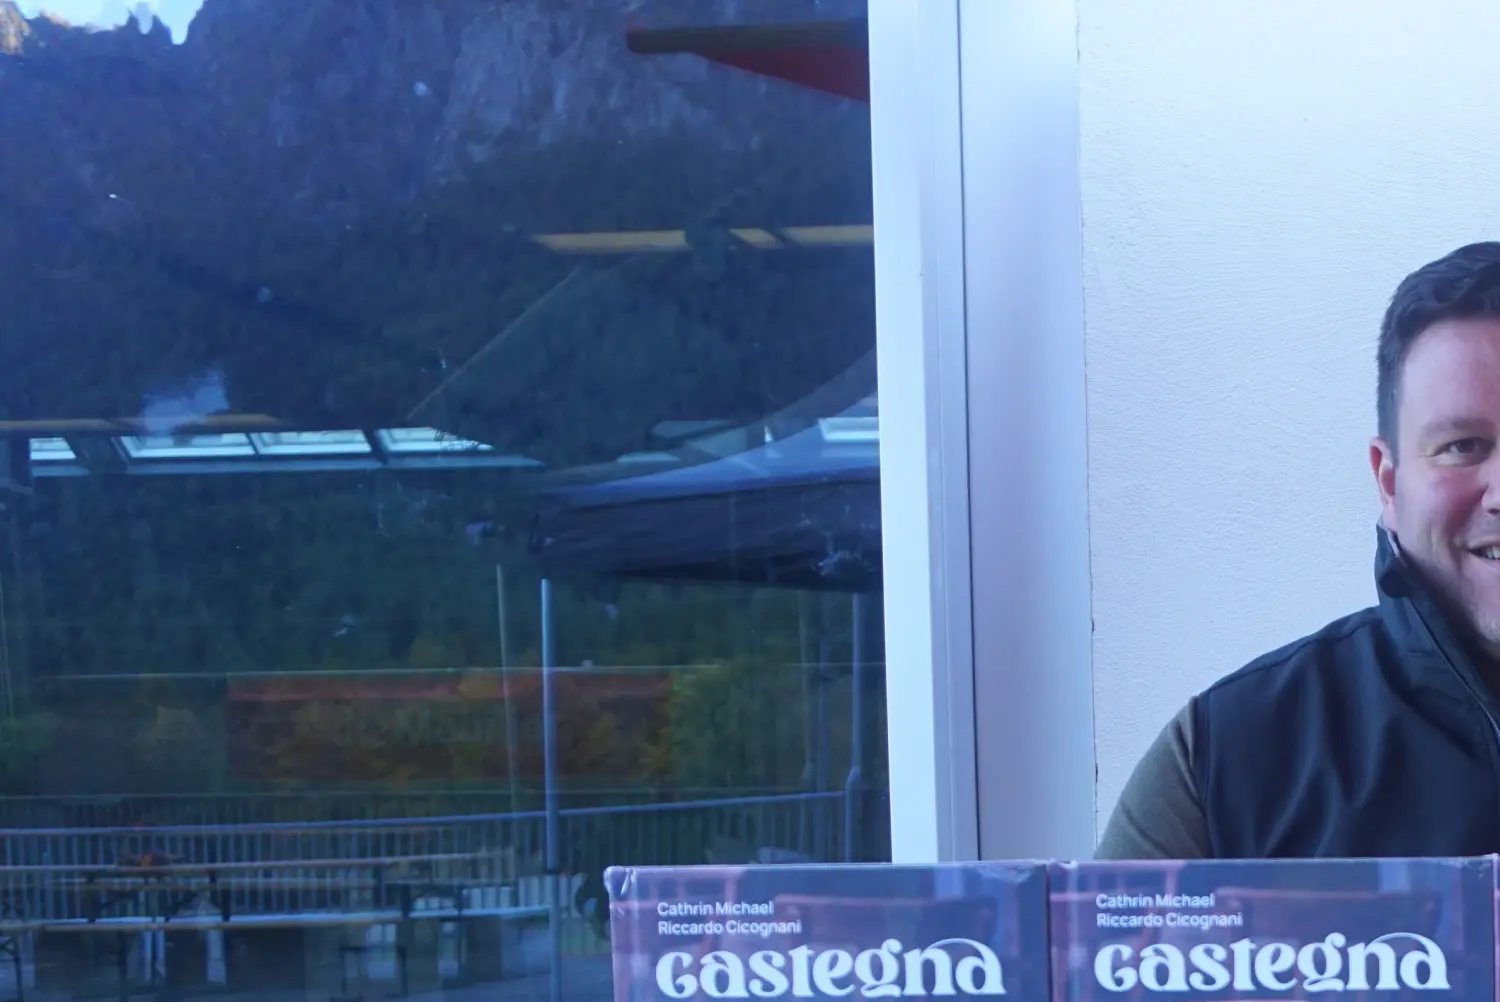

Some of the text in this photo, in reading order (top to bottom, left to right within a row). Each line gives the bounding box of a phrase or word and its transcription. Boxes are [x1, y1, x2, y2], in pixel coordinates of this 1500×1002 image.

[657, 901, 774, 916] Cathrin Michael
[1096, 893, 1215, 908] Cathrin Michael
[657, 920, 801, 938] Riccardo Cicognani
[1097, 913, 1243, 930] Riccardo Cicognani
